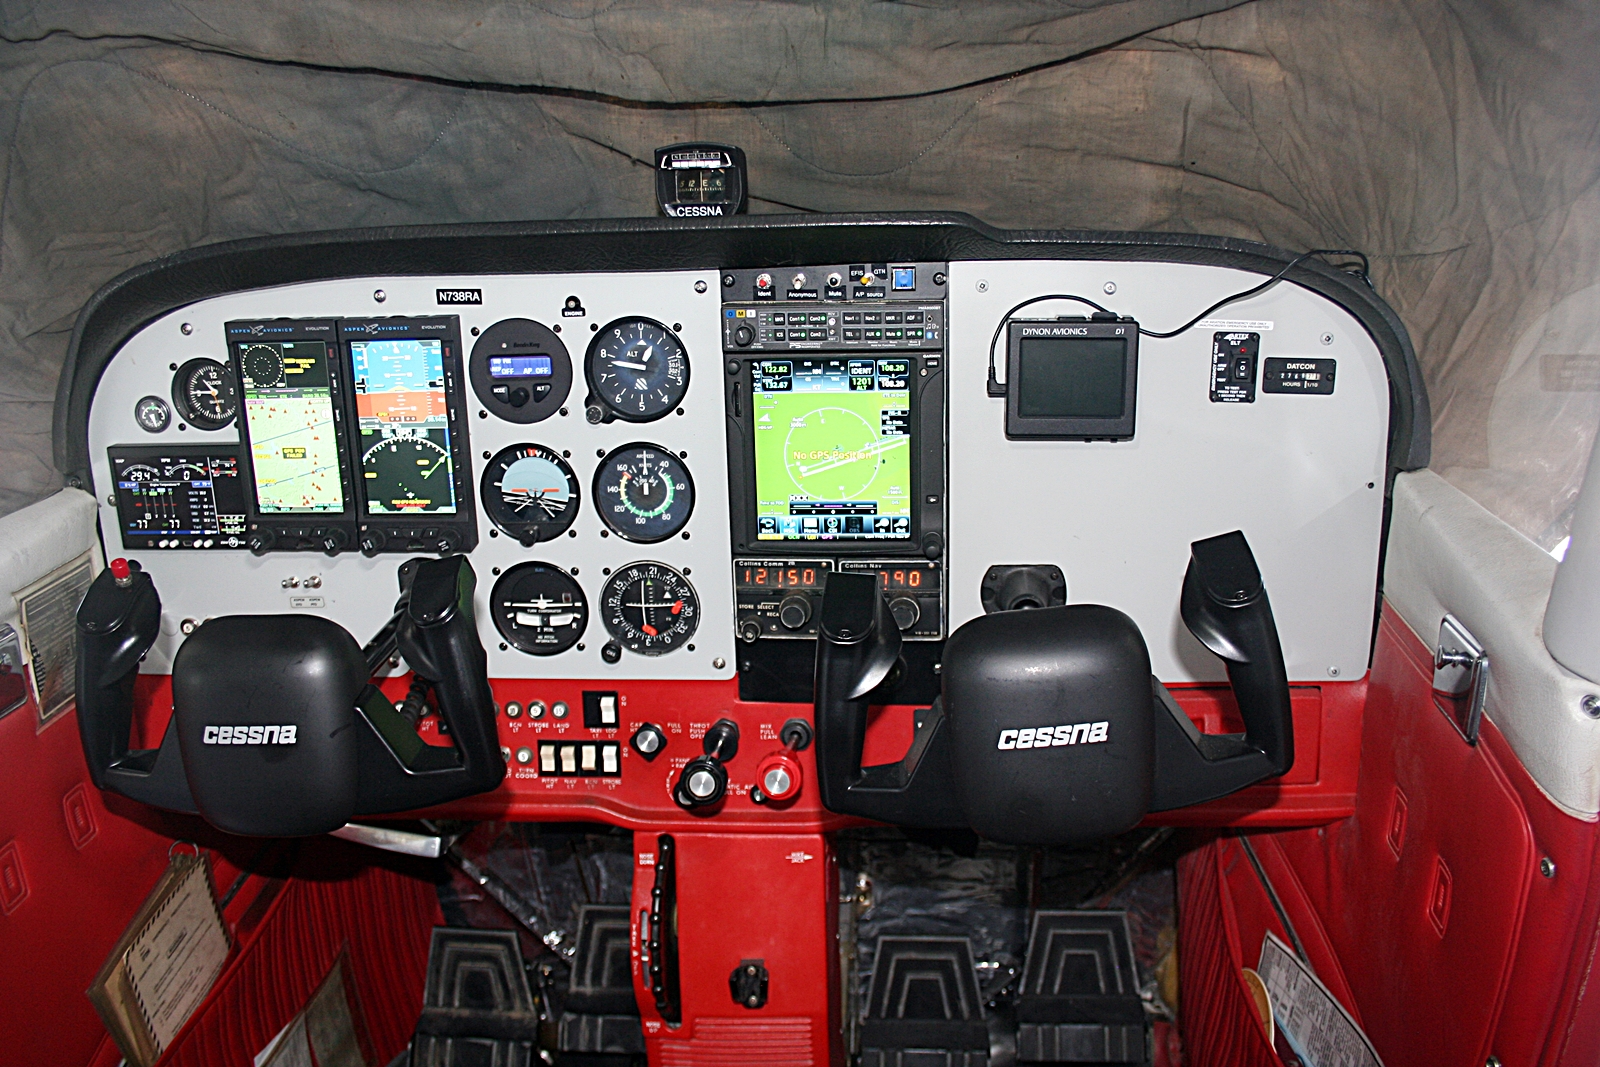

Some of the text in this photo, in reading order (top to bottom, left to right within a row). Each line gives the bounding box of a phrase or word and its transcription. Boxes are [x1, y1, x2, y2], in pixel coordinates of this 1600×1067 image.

[676, 206, 723, 217] CESSNA
[439, 291, 480, 302] N738RA
[614, 330, 621, 338] 9
[600, 349, 606, 358] 8
[675, 349, 682, 358] 2
[600, 374, 607, 383] 7
[676, 377, 682, 385] 3
[615, 394, 622, 403] 6
[662, 395, 669, 404] 4
[639, 402, 646, 411] 5
[793, 450, 872, 460] No GPS Position
[131, 472, 150, 481] 29.4
[183, 471, 190, 480] 0
[136, 520, 148, 529] 77
[169, 520, 180, 529] 77
[628, 569, 639, 578] 18
[649, 567, 658, 575] 21
[666, 572, 678, 583] 24
[613, 580, 624, 590] 15
[680, 587, 691, 597] 27
[608, 597, 617, 607] 12
[684, 606, 693, 617] 30
[677, 624, 688, 634] 33
[203, 725, 297, 745] cessna
[997, 721, 1109, 750] cessna
